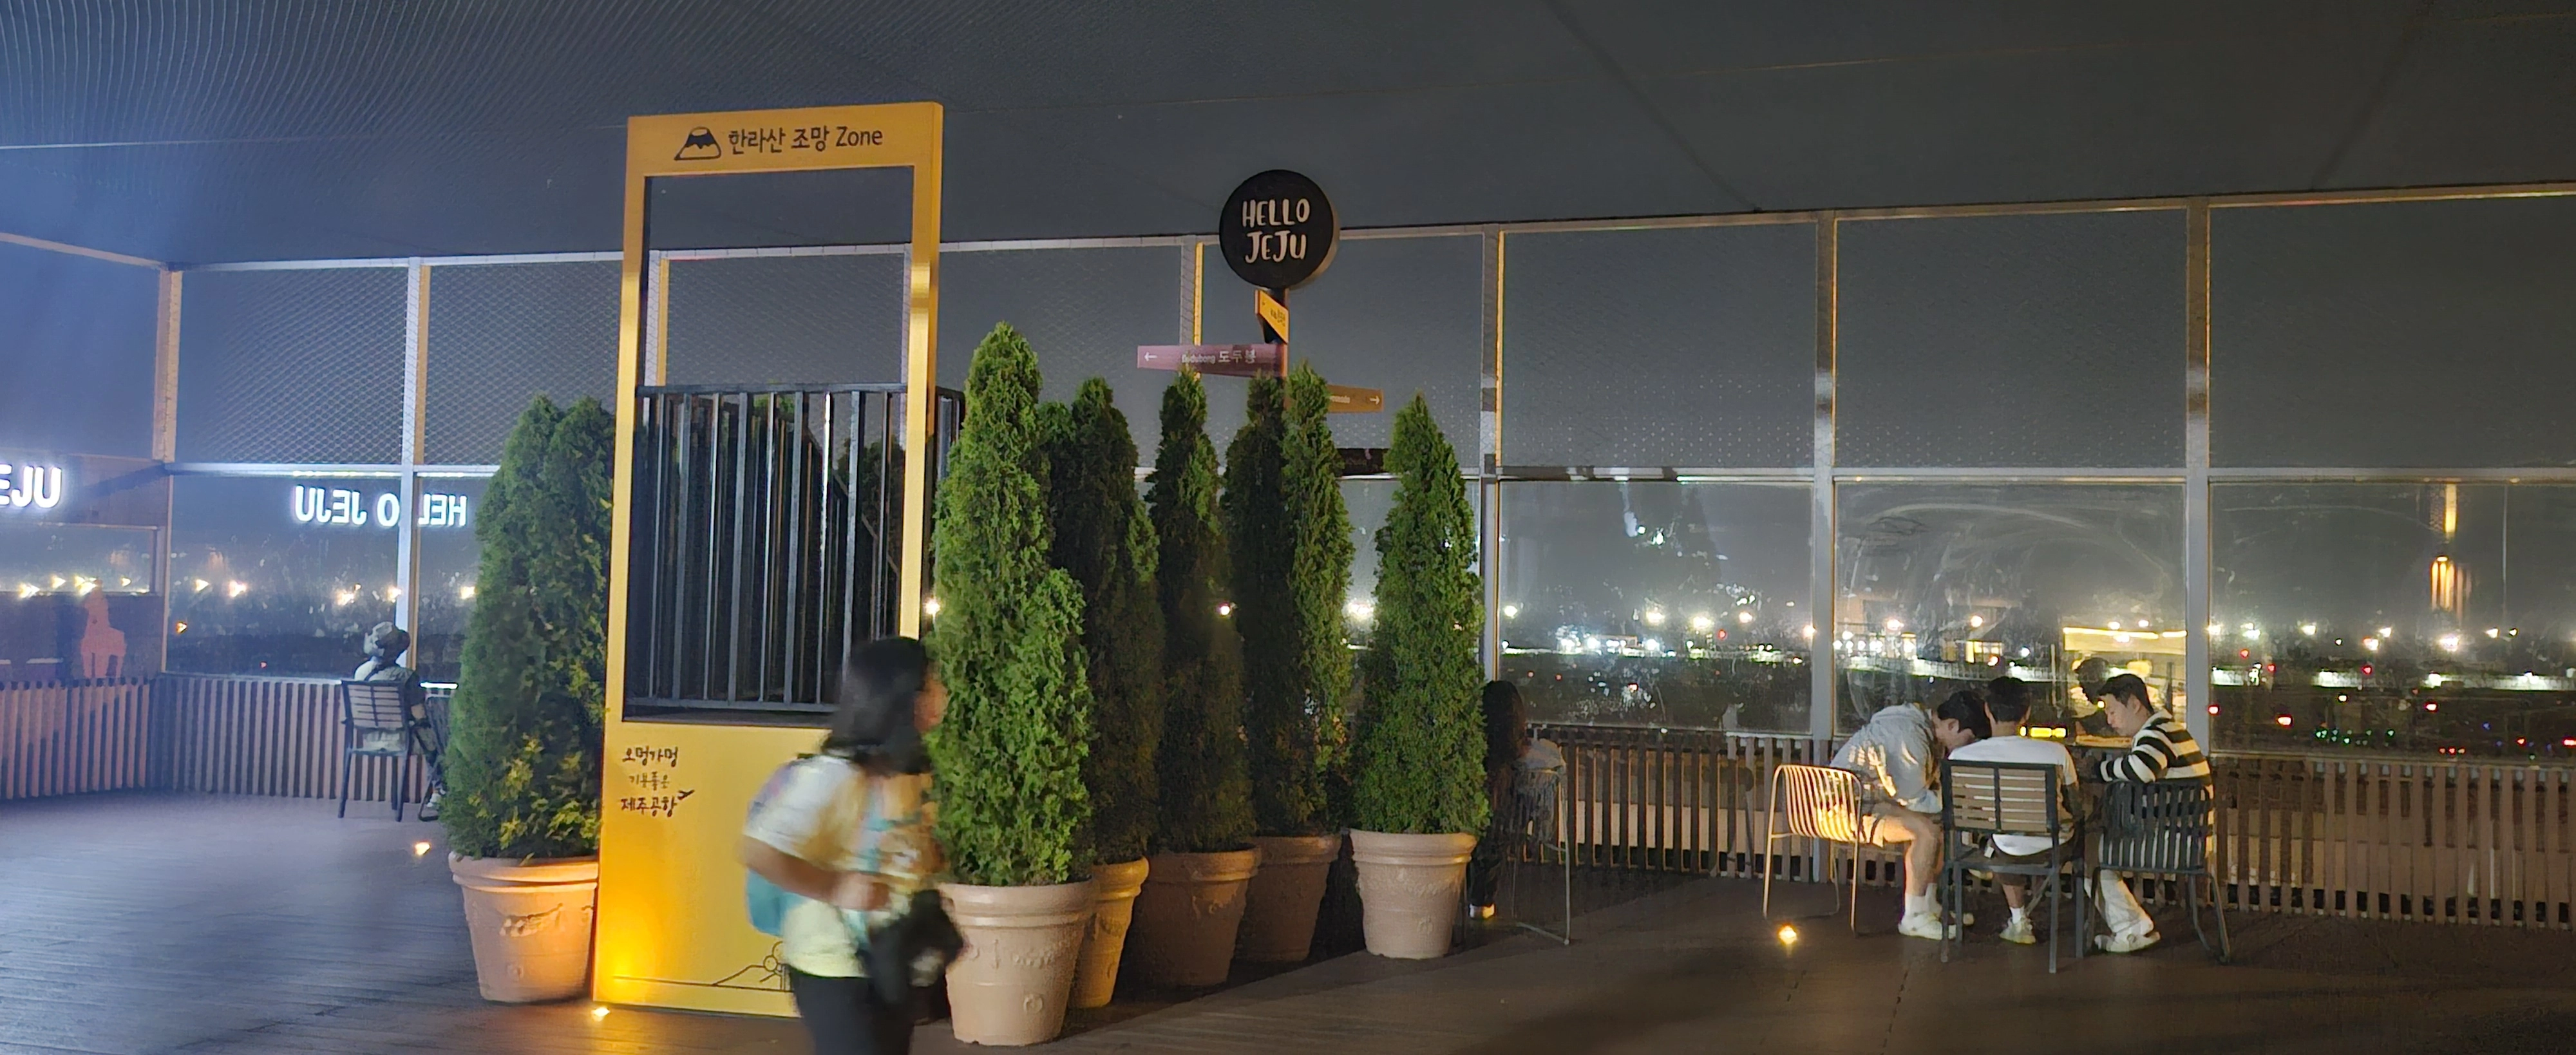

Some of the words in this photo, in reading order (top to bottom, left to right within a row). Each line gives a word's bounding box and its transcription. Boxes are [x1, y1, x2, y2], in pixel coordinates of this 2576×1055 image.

[728, 127, 786, 155] 한라산
[791, 125, 830, 152] 조망
[835, 126, 884, 147] Zone
[1242, 198, 1310, 227] HELLO
[1245, 230, 1307, 263] JEJU
[1218, 349, 1256, 364] 도두봉
[622, 746, 679, 767] 오멍가멍
[620, 795, 677, 817] 제주공항
